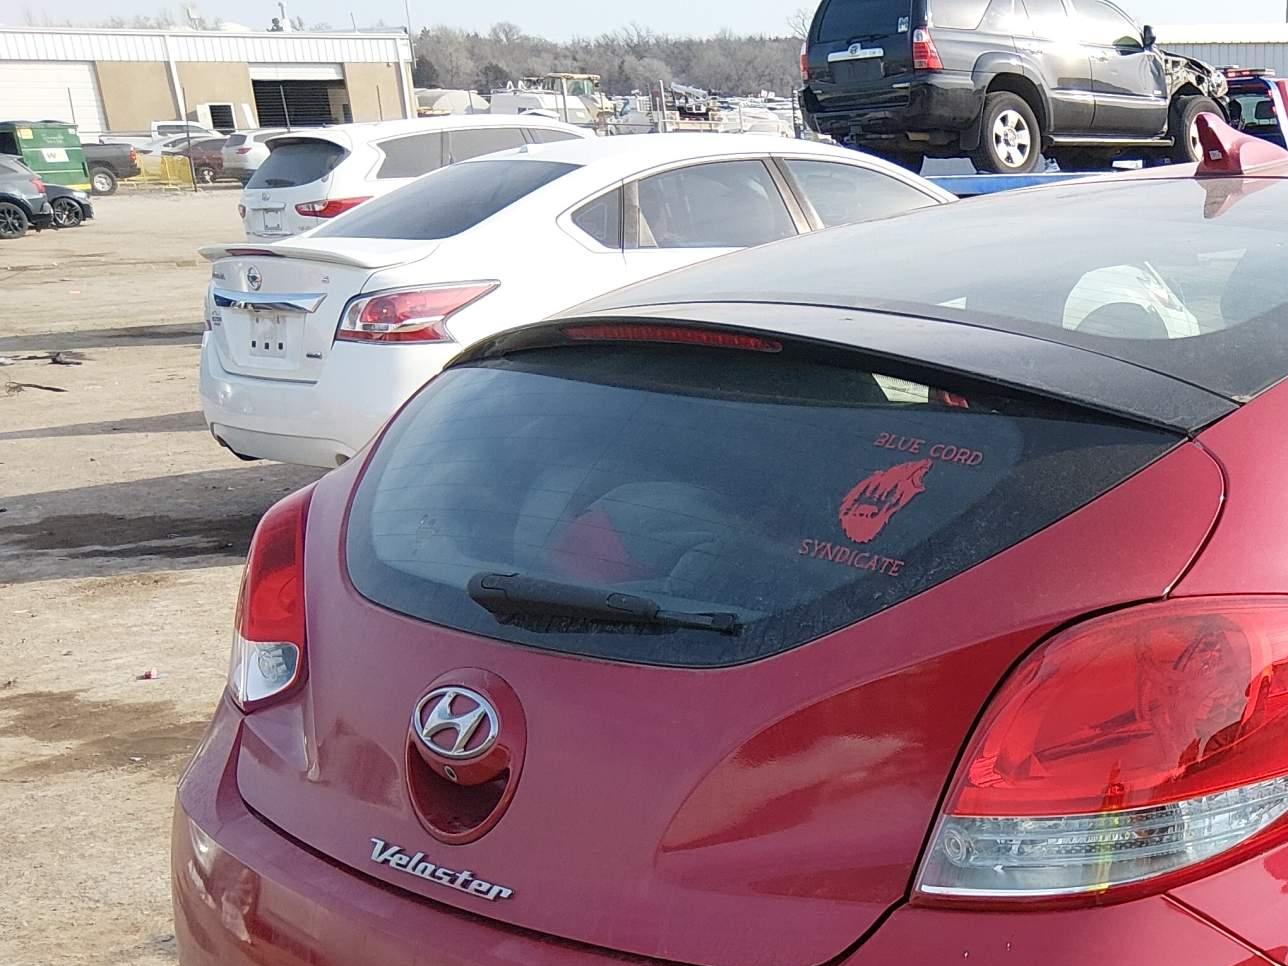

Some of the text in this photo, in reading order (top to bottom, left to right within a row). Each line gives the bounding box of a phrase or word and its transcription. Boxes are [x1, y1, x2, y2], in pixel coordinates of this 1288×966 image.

[873, 431, 984, 467] BLUE CORD
[797, 538, 905, 577] SYNDICATE
[370, 837, 515, 902] Veloster
